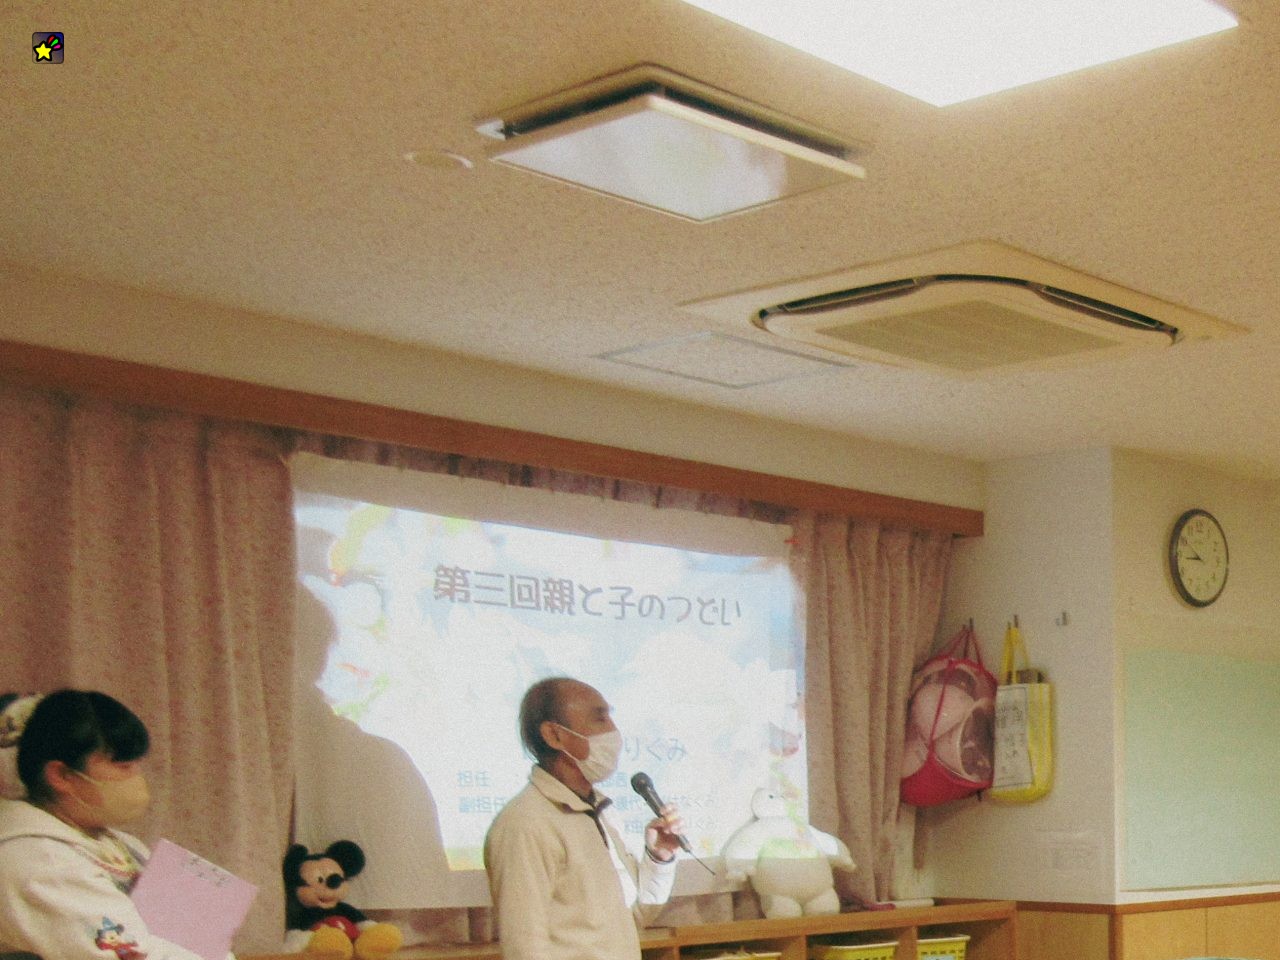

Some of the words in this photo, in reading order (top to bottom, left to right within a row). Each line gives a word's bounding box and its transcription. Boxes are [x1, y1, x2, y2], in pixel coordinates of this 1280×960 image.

[433, 564, 742, 626] 第三回親と子のつどい
